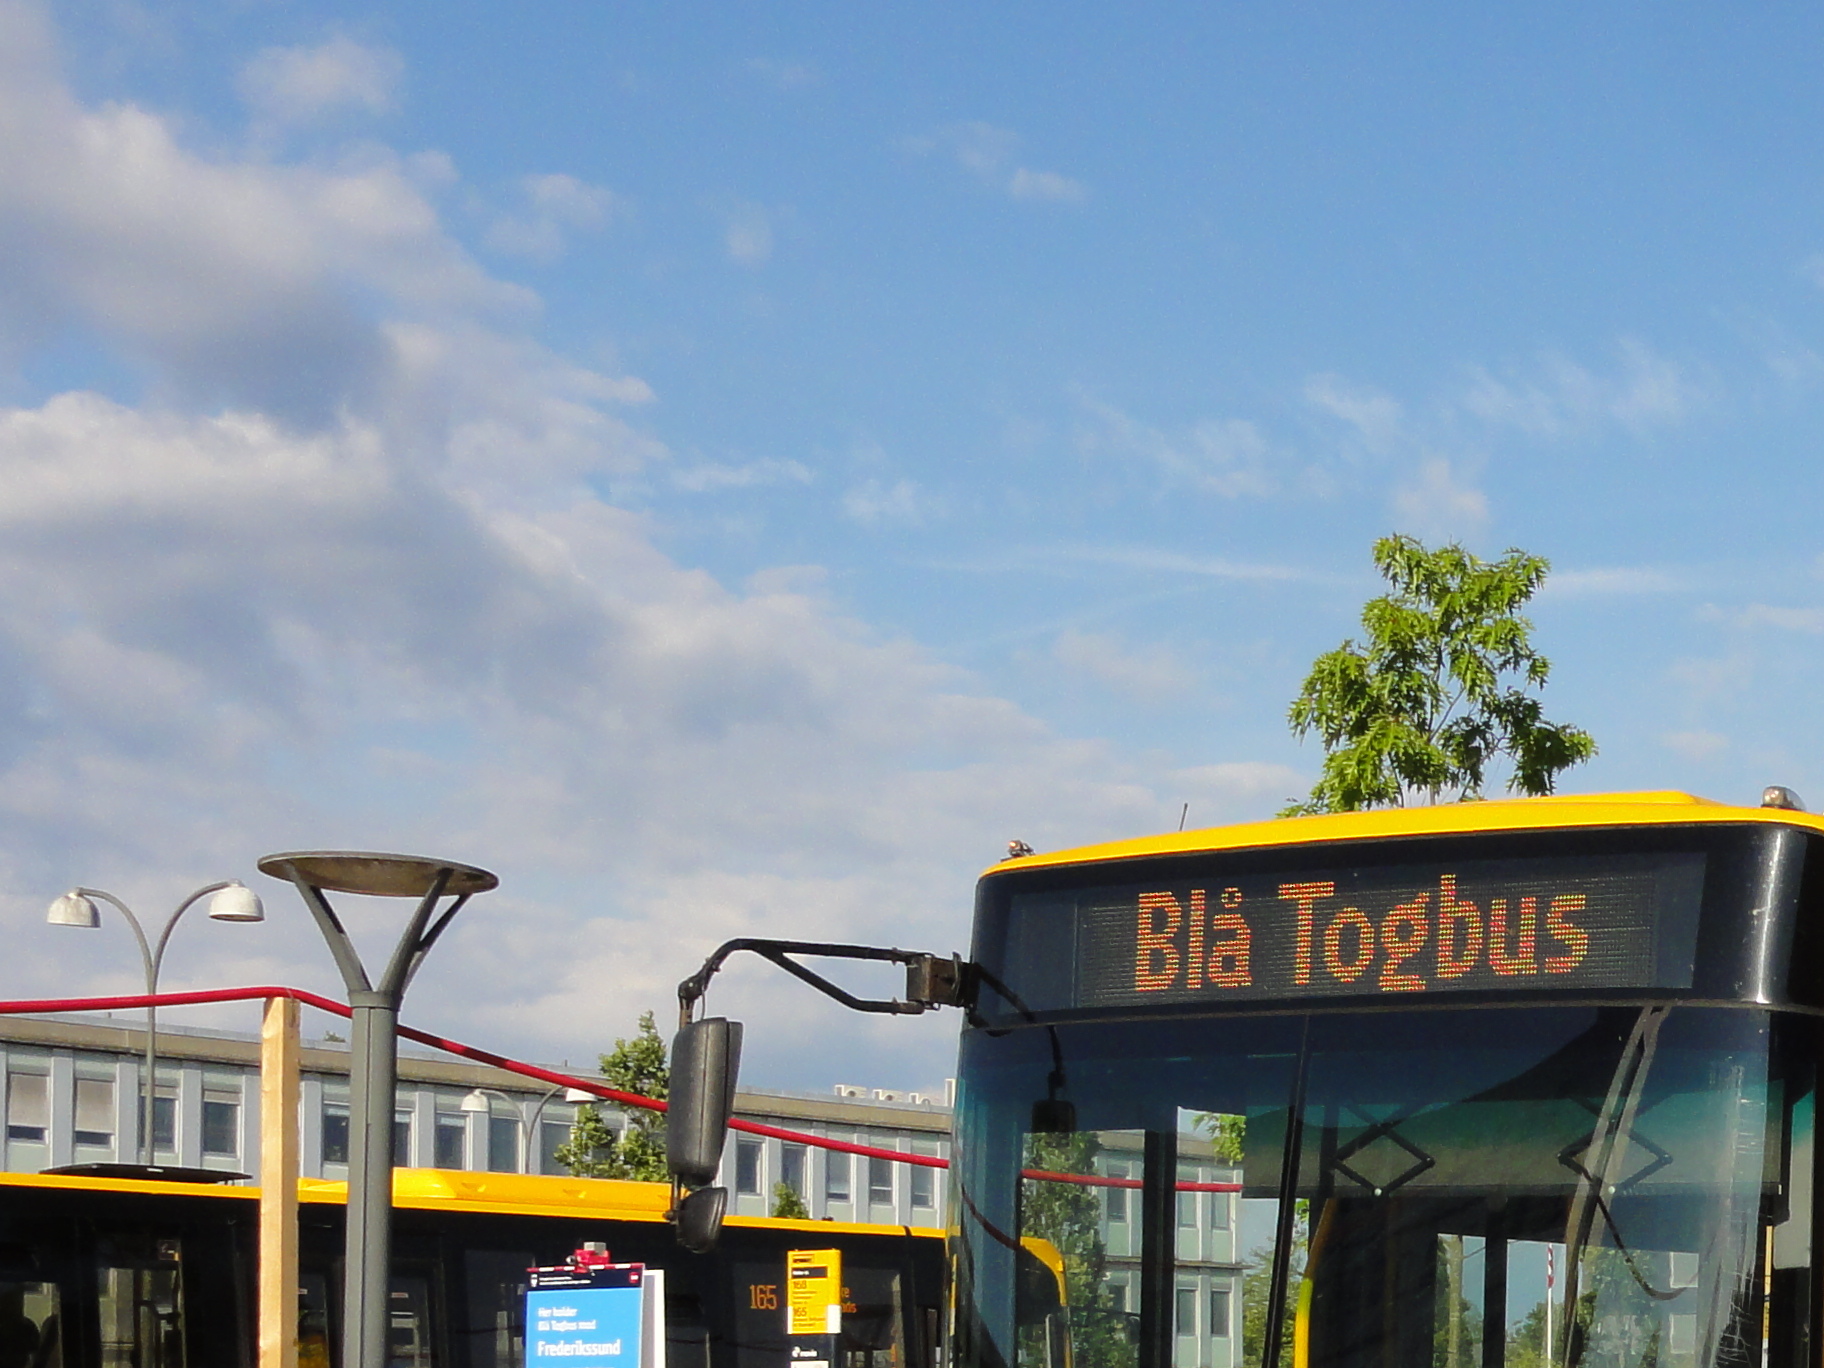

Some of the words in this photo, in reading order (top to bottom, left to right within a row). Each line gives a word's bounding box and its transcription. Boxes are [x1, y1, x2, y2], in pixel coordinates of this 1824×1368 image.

[1135, 887, 1253, 991] Blå
[1278, 874, 1588, 992] Togbus
[749, 1284, 777, 1310] 165
[537, 1339, 621, 1356] Frederikssund
